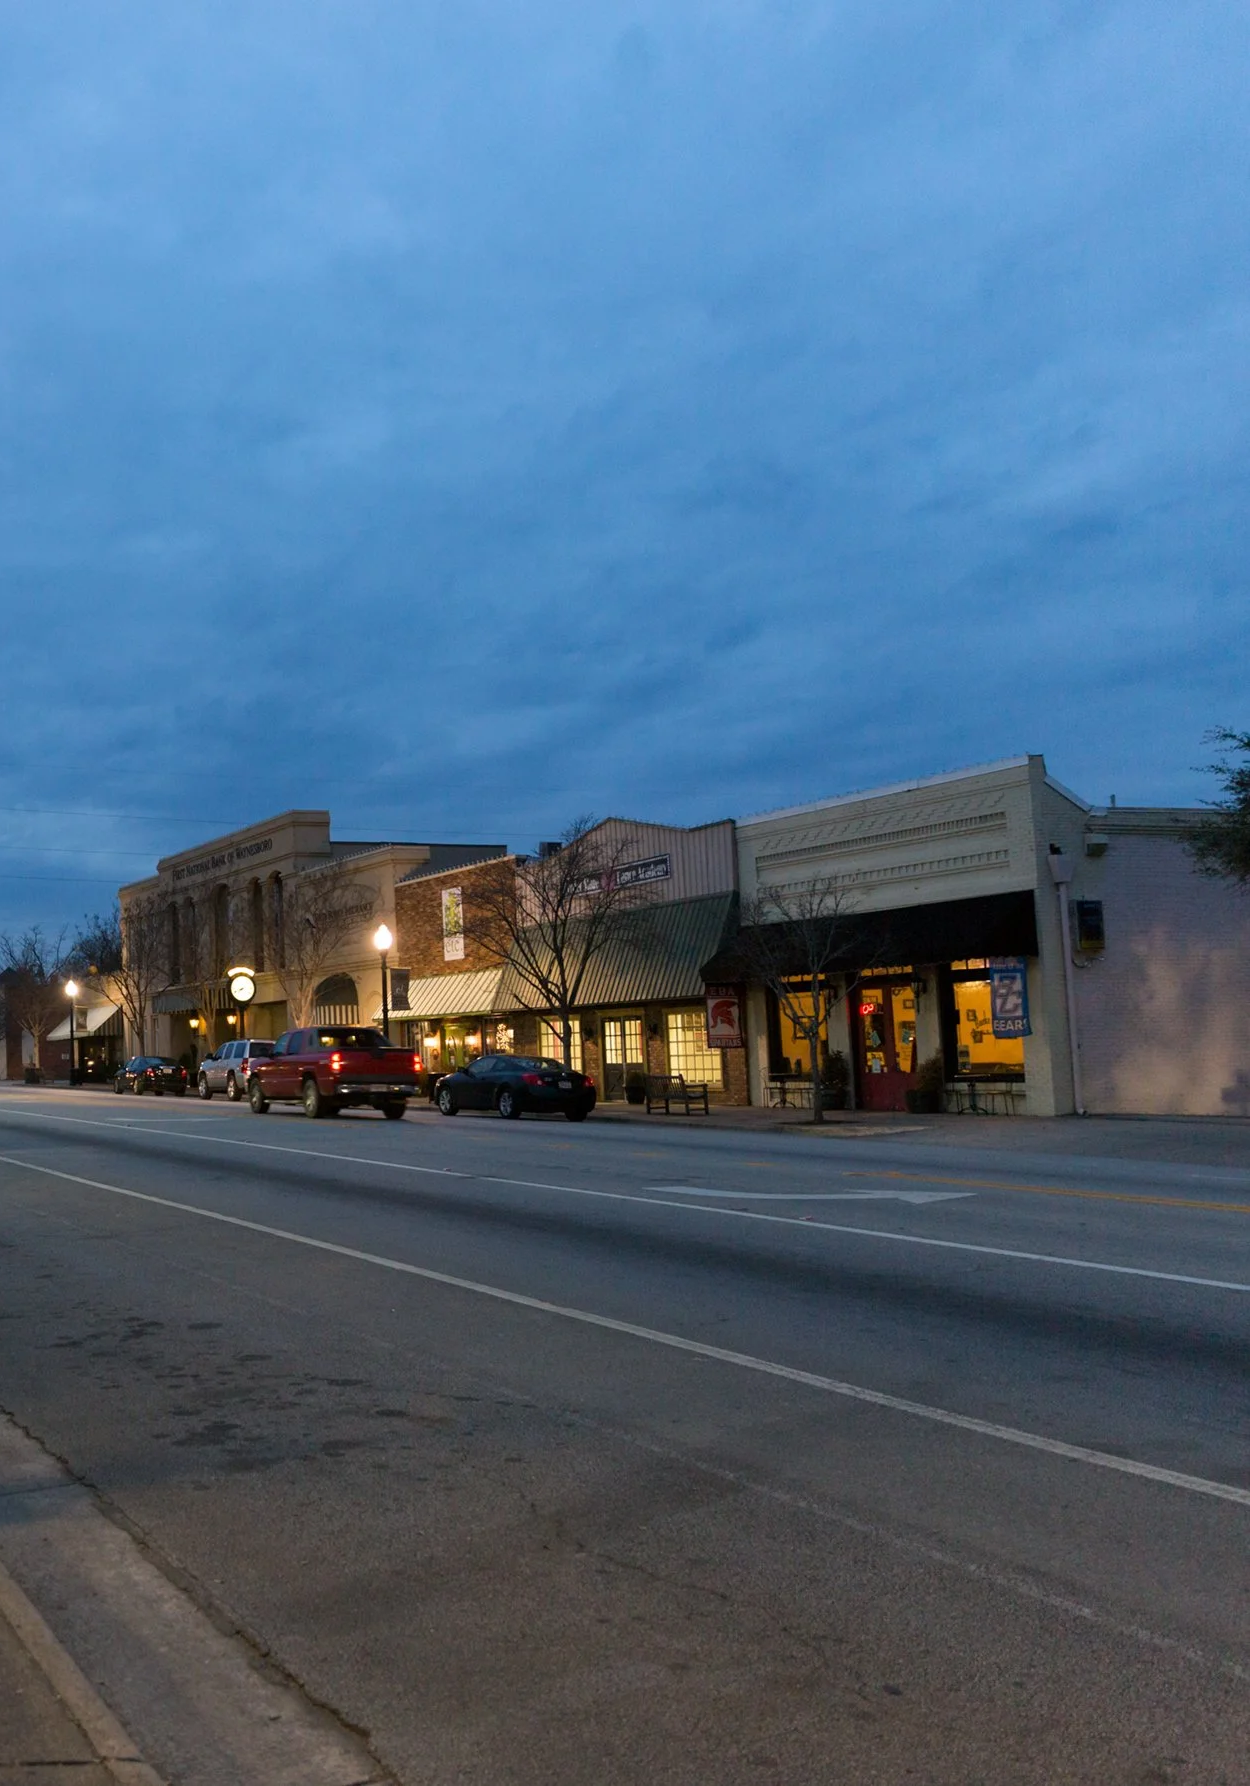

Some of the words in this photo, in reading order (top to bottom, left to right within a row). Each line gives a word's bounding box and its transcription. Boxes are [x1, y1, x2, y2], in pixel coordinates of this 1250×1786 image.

[211, 854, 226, 870] BANK
[227, 851, 235, 864] OF
[235, 838, 273, 859] WAYNESBORO
